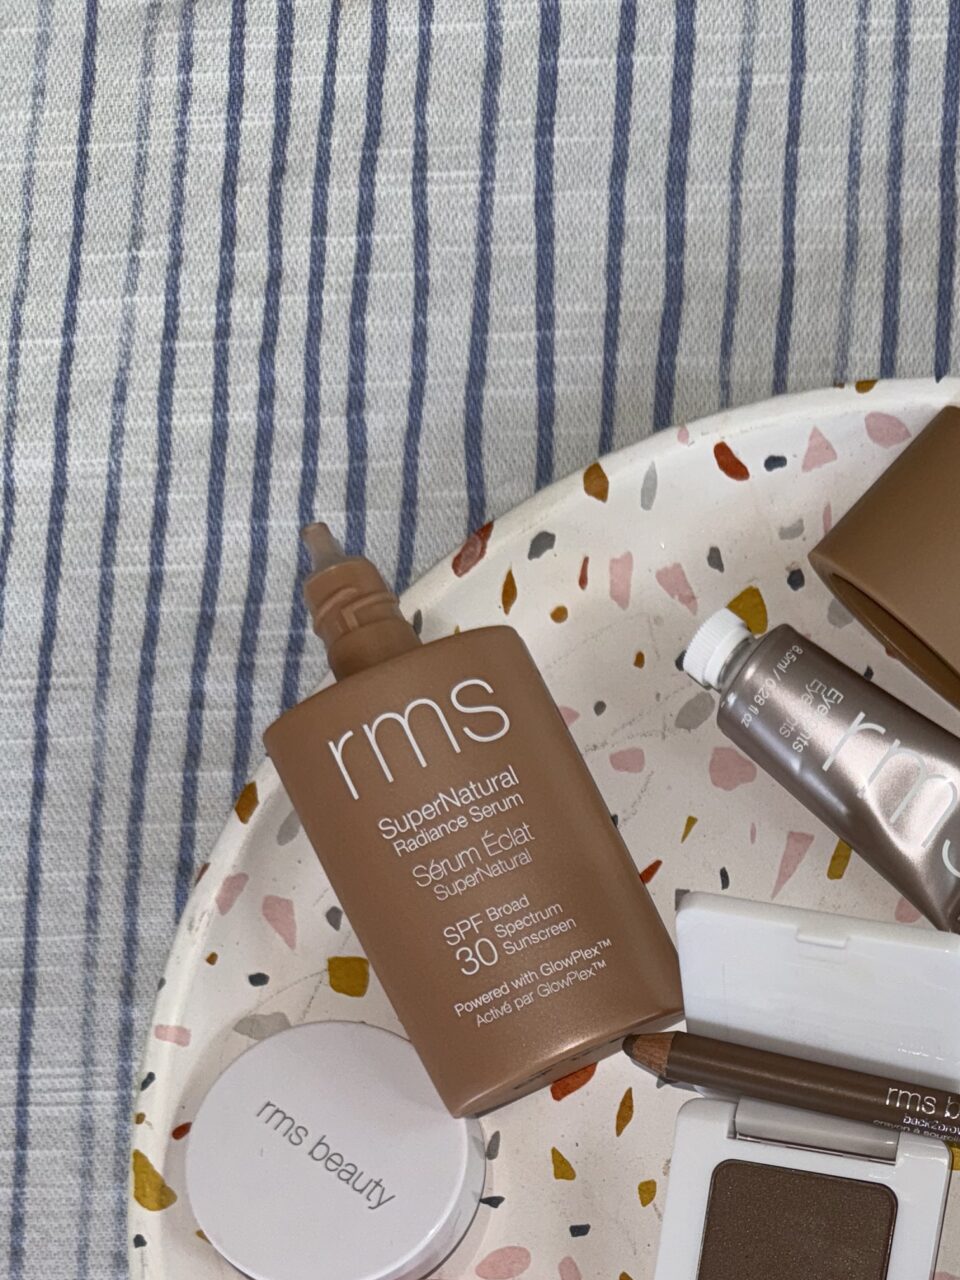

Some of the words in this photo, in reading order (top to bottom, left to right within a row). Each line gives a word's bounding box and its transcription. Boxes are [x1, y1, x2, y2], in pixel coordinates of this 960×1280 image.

[776, 644, 804, 673] 8.5ml
[327, 678, 511, 800] rms
[740, 712, 753, 729] oz
[378, 763, 520, 840] SuperNatural
[392, 815, 469, 858] Radiance
[468, 792, 525, 823] Serum
[412, 846, 483, 888] Sérum
[481, 821, 536, 857] Éclat
[433, 847, 533, 901] SuperNatural
[443, 912, 484, 946] SPF
[485, 893, 531, 922] Broad
[493, 902, 564, 939] Spectrum
[502, 917, 577, 956] Sunscreen
[455, 937, 499, 976] 30
[453, 981, 511, 1018] Powered
[510, 969, 540, 990] with
[475, 1000, 513, 1028] Activé
[514, 991, 535, 1012] par
[885, 1086, 938, 1115] rms
[256, 1100, 309, 1147] rms
[307, 1134, 397, 1211] beauty
